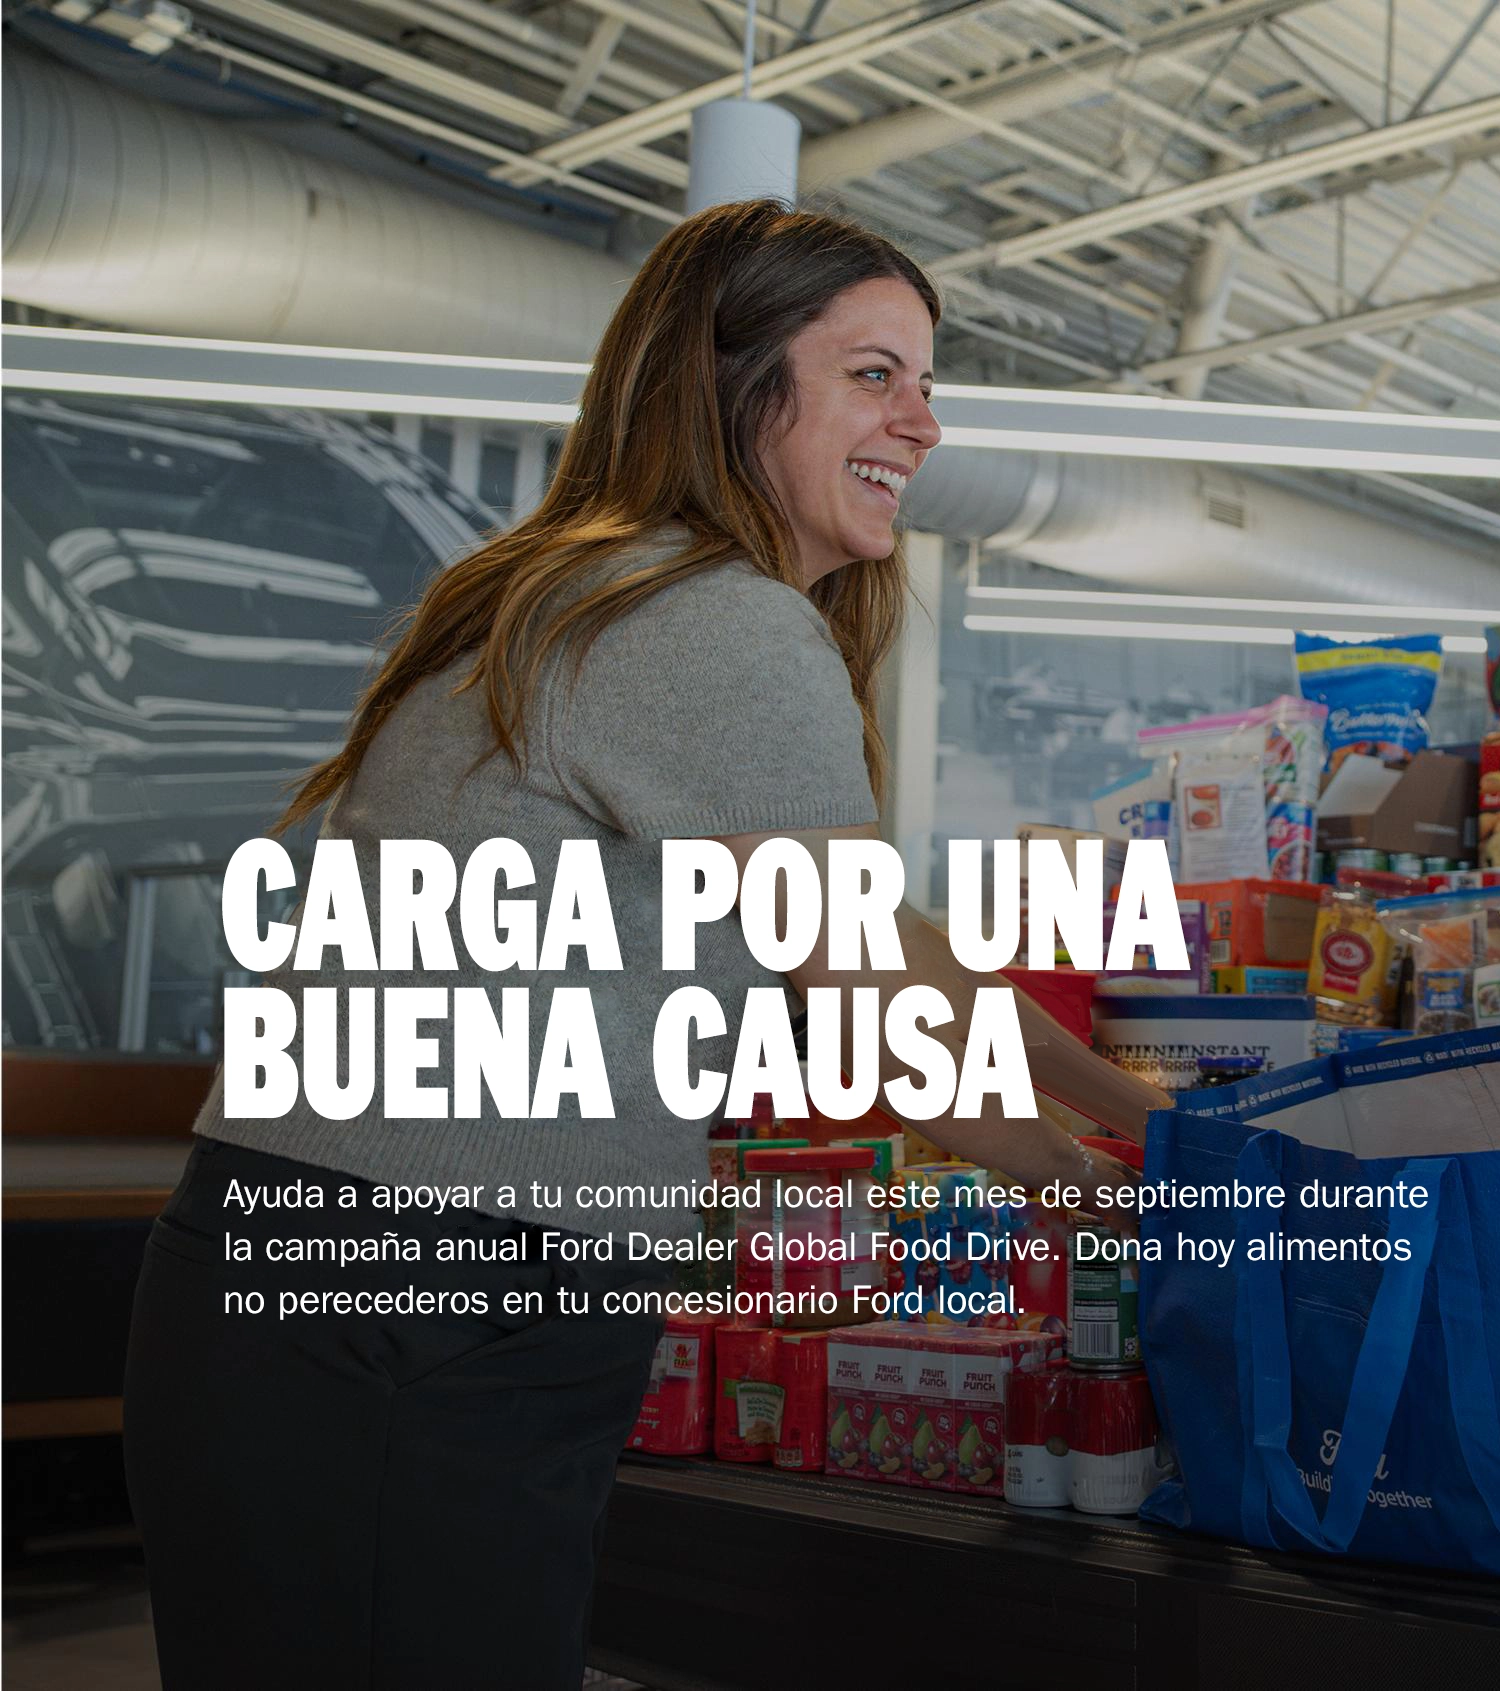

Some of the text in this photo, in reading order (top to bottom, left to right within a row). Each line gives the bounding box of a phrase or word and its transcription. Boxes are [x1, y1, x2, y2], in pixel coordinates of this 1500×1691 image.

[838, 1360, 861, 1373] FRUIT
[877, 1364, 903, 1377] FRUIT
[836, 1369, 862, 1380] PUNCH
[874, 1373, 904, 1385] PUNCH
[922, 1368, 945, 1380] FRUIT
[966, 1372, 993, 1384] FRUIT
[919, 1377, 947, 1389] PUNCH
[963, 1382, 996, 1393] PUNCH
[1368, 1489, 1433, 1510] ogether
